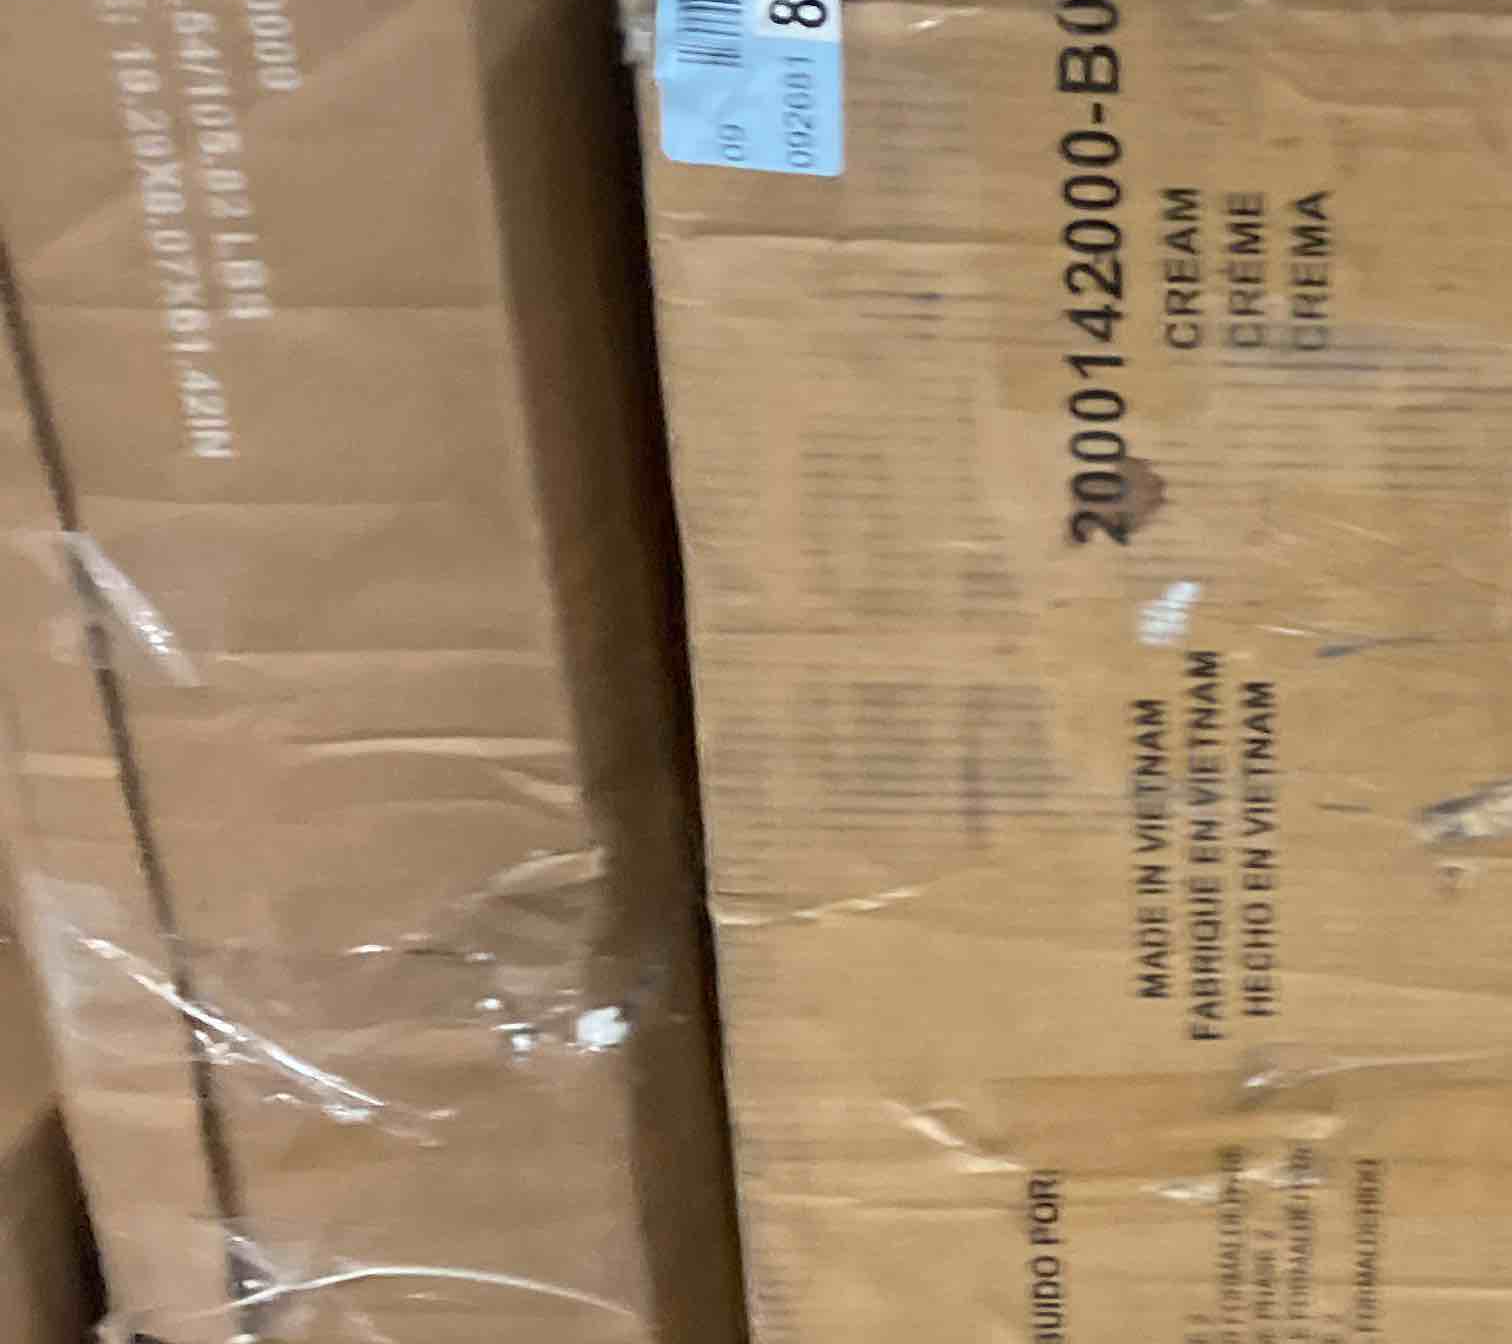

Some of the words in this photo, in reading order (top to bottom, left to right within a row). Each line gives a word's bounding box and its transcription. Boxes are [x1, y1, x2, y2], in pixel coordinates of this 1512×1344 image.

[1161, 187, 1201, 351] CREAM
[1292, 190, 1330, 351] CREMA
[1133, 699, 1170, 853] VIETNAM
[1187, 651, 1223, 806] VIETNAM
[1242, 682, 1276, 837] VIETNAM
[1135, 865, 1170, 894] IN
[1189, 819, 1223, 864] EN
[1243, 848, 1276, 891] EN
[1135, 905, 1171, 999] MADE
[1243, 902, 1277, 1017] HECHO
